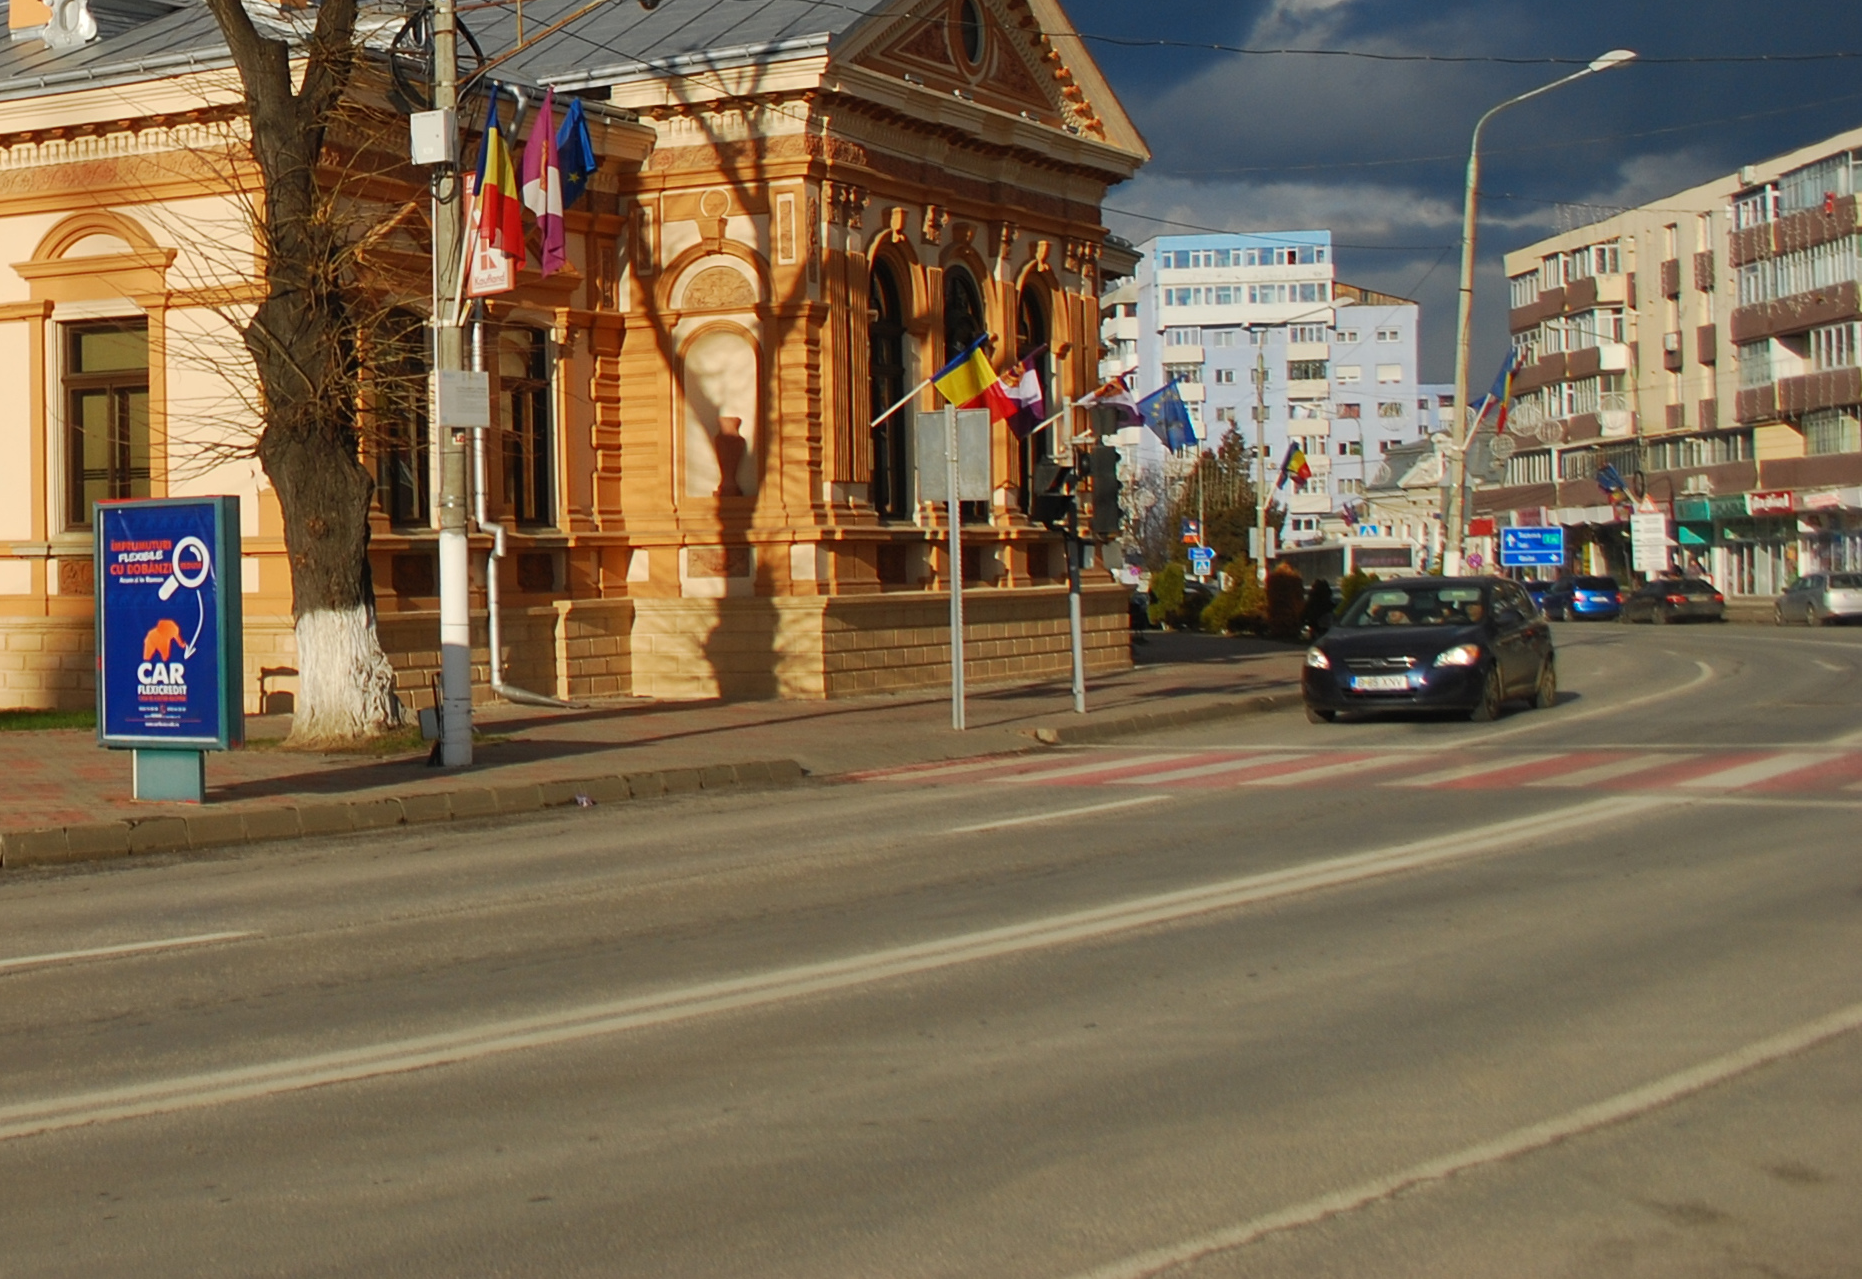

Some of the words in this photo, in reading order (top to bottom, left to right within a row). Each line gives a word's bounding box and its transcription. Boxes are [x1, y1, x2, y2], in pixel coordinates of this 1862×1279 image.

[110, 563, 124, 575] CU
[137, 662, 185, 685] CAR
[137, 684, 188, 695] FLEXICREDIT
